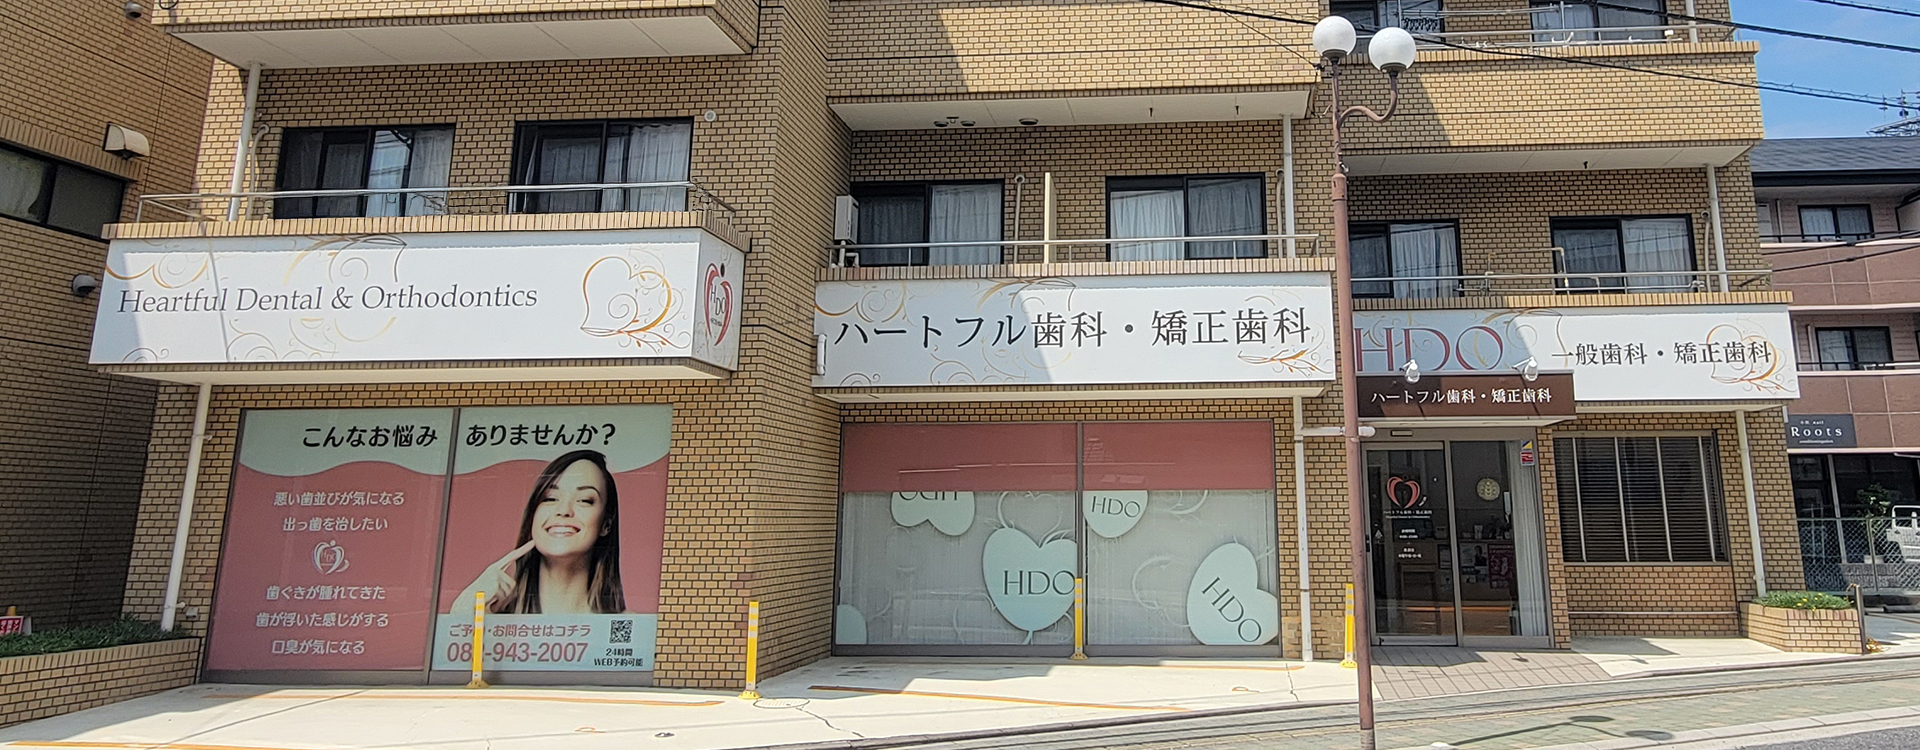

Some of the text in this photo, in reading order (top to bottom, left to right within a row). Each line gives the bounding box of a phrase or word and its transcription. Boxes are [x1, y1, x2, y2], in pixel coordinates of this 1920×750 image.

[118, 283, 538, 314] Heartful Dental & Orthodontics
[834, 307, 1311, 350] ハートフル歯科・矯正歯科
[1354, 325, 1503, 371] HDO
[1551, 339, 1772, 366] 一般歯科・矯正歯科
[1371, 387, 1552, 405] ハートフル歯科・矯正歯科
[302, 423, 616, 447] こんなお悩み ありませんか?
[1790, 426, 1843, 437] Roots
[273, 491, 405, 506] 悪い歯並びが気になる
[1091, 495, 1141, 518] HDO
[283, 516, 388, 532] 出っ歯を治したい
[1003, 570, 1076, 595] HDO
[266, 585, 386, 600] 歯ぐきが腫れてきた
[1202, 577, 1262, 643] HDO
[256, 612, 389, 627] 歯が浮いた感じがする
[449, 624, 591, 638] ご予・お問合せはコチラ
[271, 639, 365, 655] 口臭が気になる
[447, 642, 588, 663] 08-943-2007
[605, 648, 634, 657] 24時間
[594, 658, 644, 667] WEB予約可能
